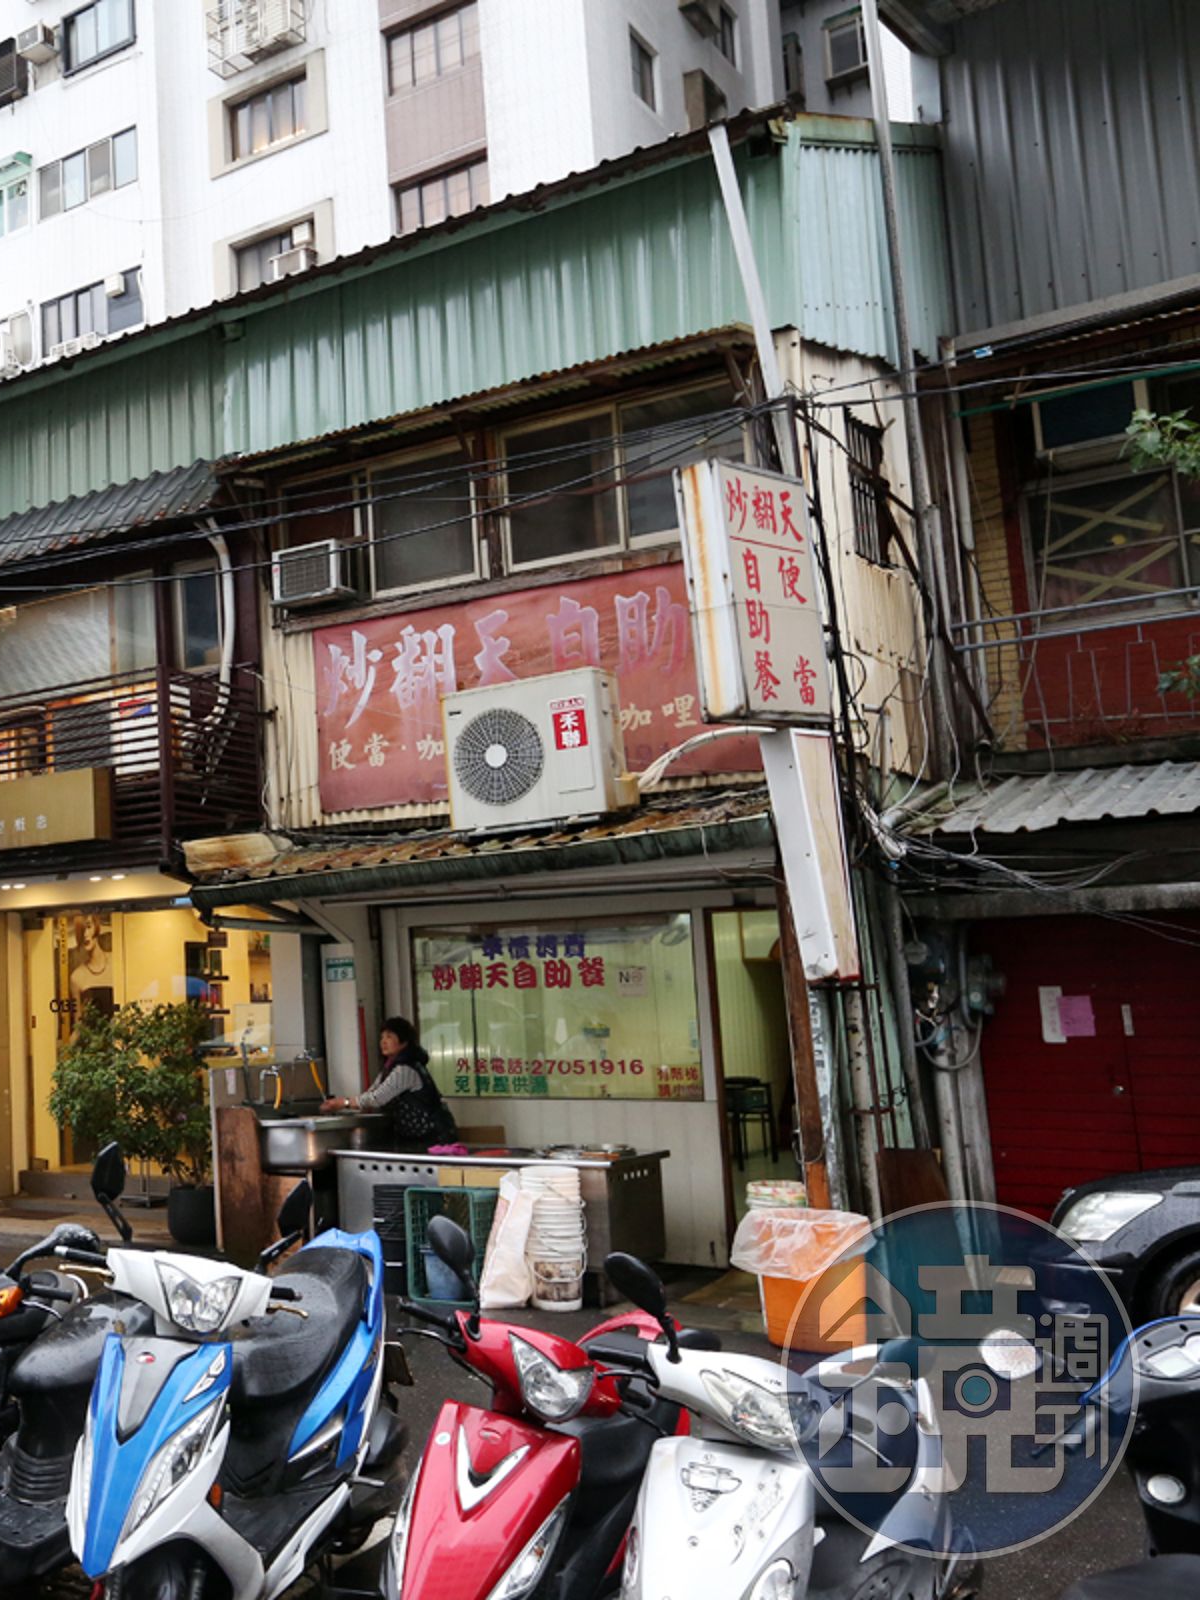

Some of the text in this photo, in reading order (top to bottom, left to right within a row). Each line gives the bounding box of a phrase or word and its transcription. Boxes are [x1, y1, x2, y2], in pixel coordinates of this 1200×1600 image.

[726, 478, 803, 542] 炒翻天
[742, 547, 781, 702] 自助餐
[777, 556, 817, 706] 便當
[432, 957, 605, 990] 炒翻天自助餐
